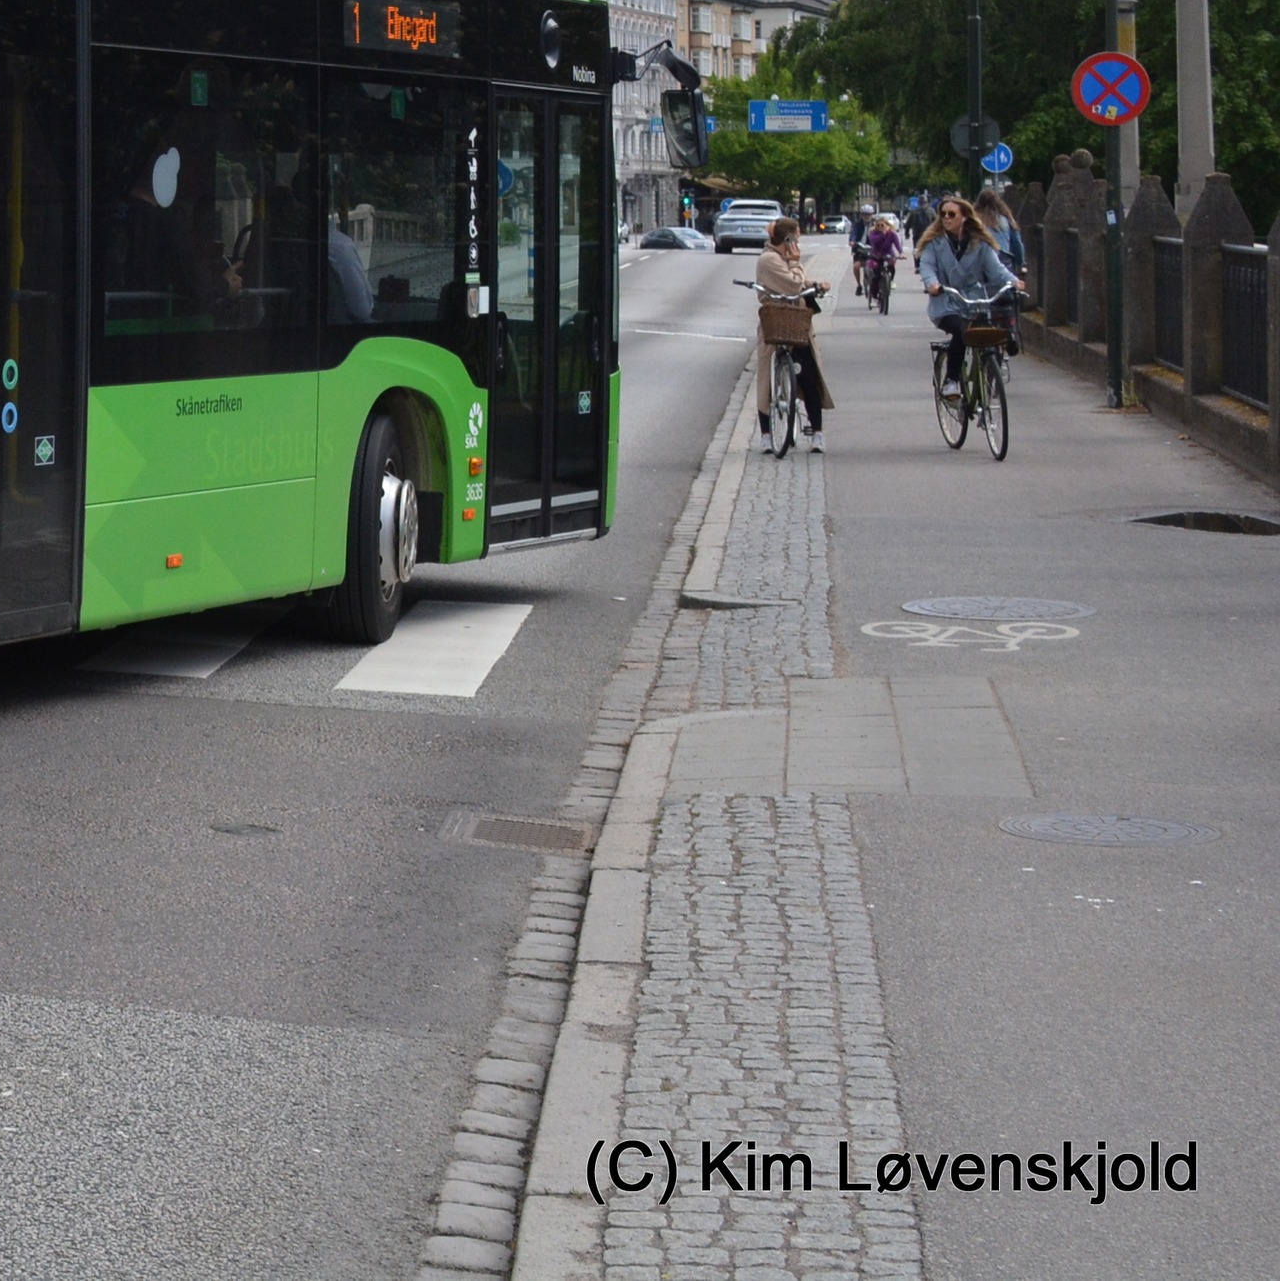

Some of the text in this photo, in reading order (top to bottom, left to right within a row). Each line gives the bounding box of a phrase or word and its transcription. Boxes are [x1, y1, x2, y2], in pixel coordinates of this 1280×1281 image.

[353, 1, 437, 50] 1 Elinegård
[572, 64, 596, 84] Nobina
[175, 393, 243, 417] Skånetrafiken
[465, 482, 484, 502] 3635
